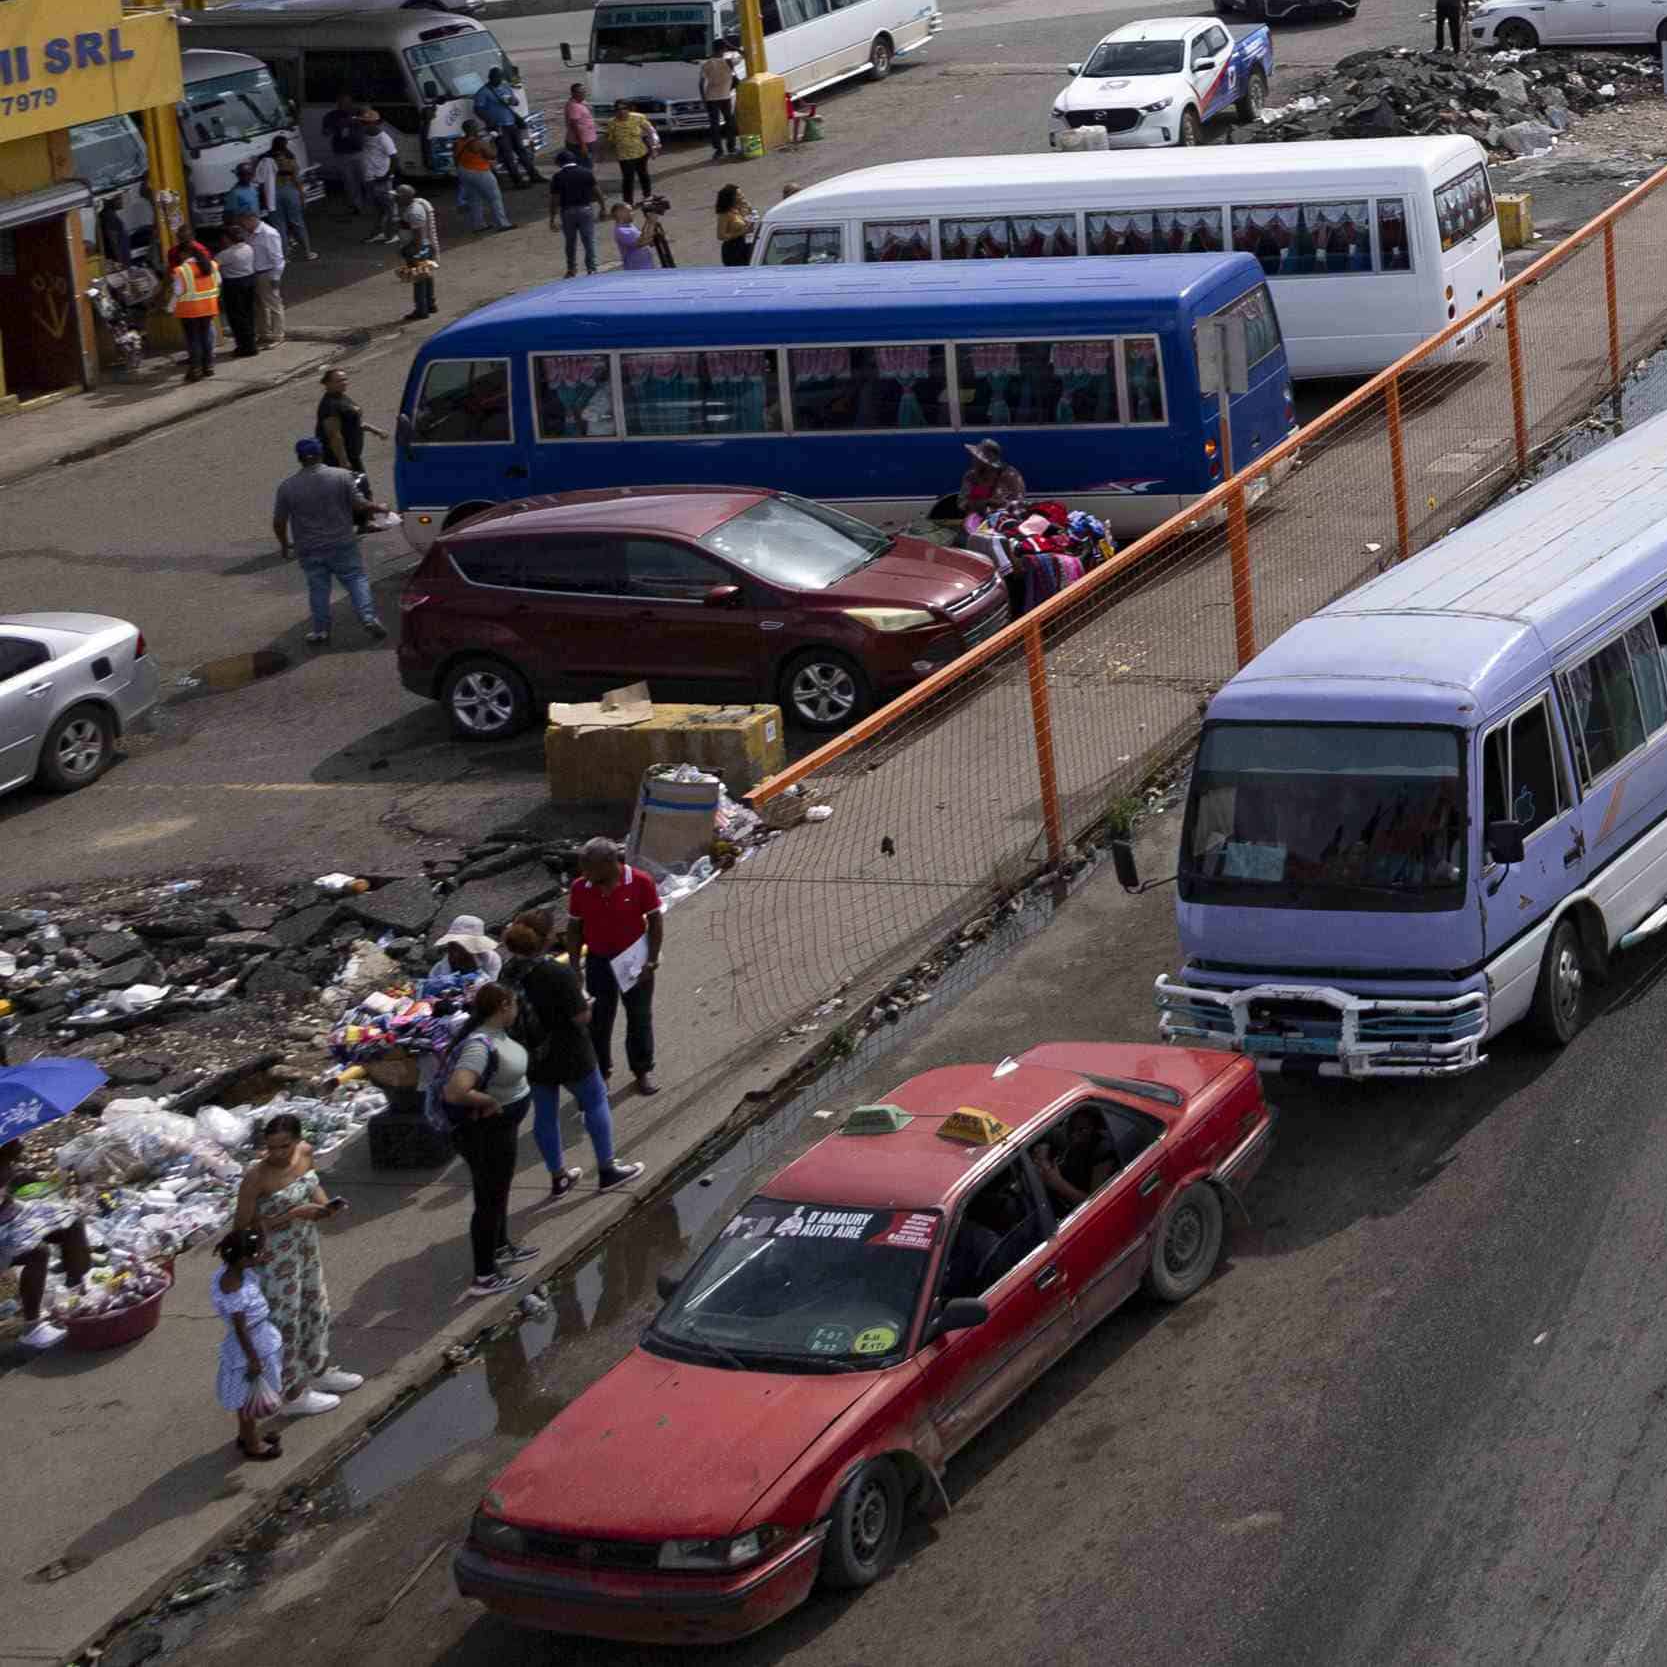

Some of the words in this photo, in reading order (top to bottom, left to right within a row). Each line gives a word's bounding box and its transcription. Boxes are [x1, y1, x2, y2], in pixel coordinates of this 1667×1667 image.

[44, 27, 135, 74] SRL
[1, 87, 57, 116] 7979
[799, 1223, 833, 1237] AUTO
[833, 1226, 865, 1239] AIRE
